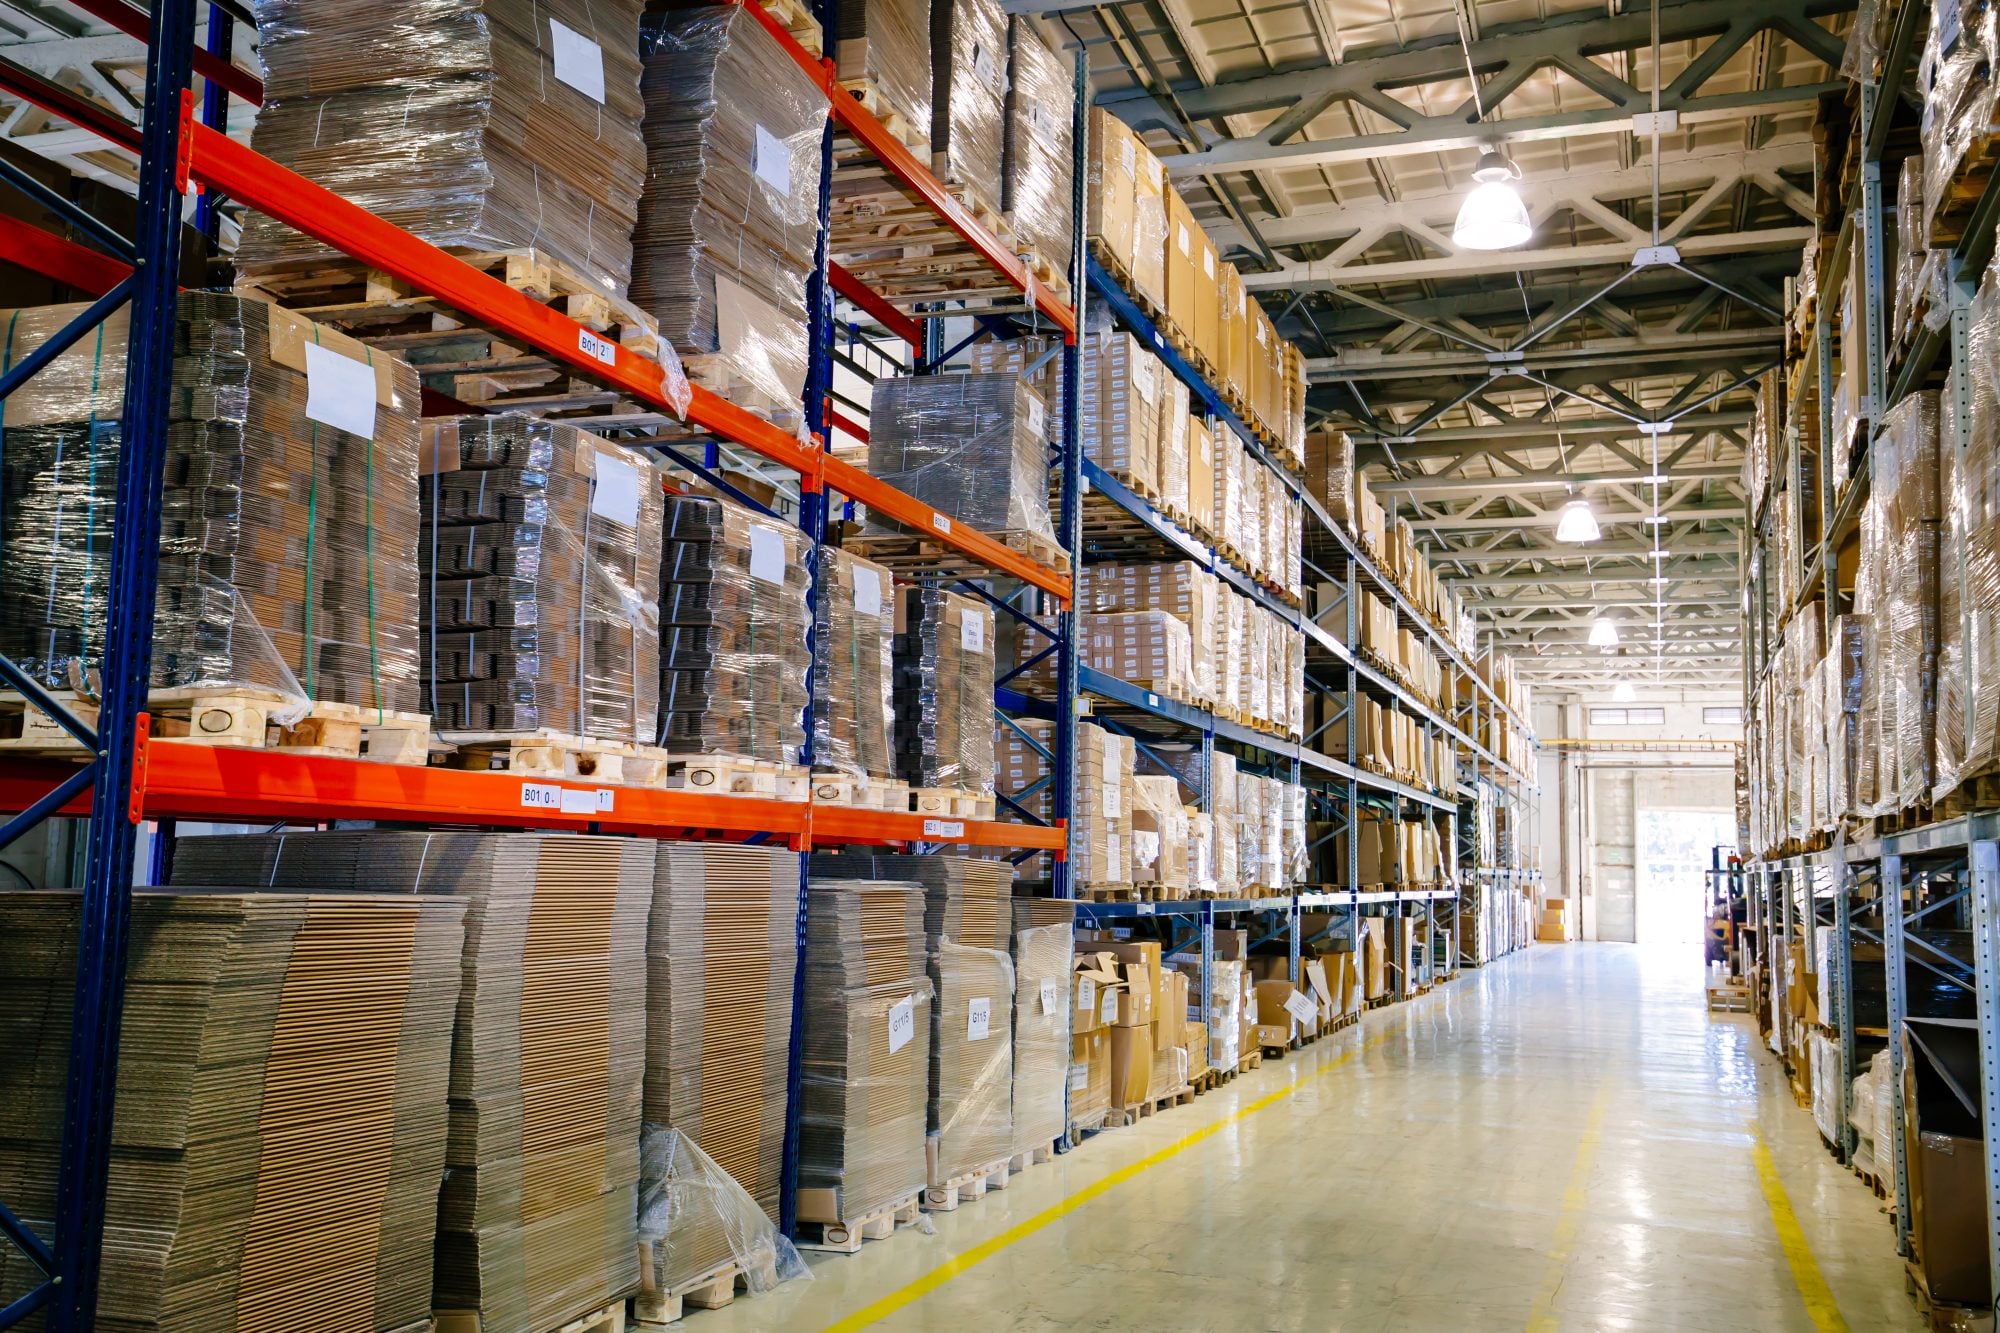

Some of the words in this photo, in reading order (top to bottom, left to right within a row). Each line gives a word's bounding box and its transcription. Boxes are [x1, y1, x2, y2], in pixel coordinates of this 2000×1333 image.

[581, 336, 596, 354] B01
[600, 344, 606, 356] 2
[524, 788, 540, 802] B01
[544, 791, 550, 804] 0
[599, 792, 604, 804] 1
[892, 1011, 910, 1032] G11/5
